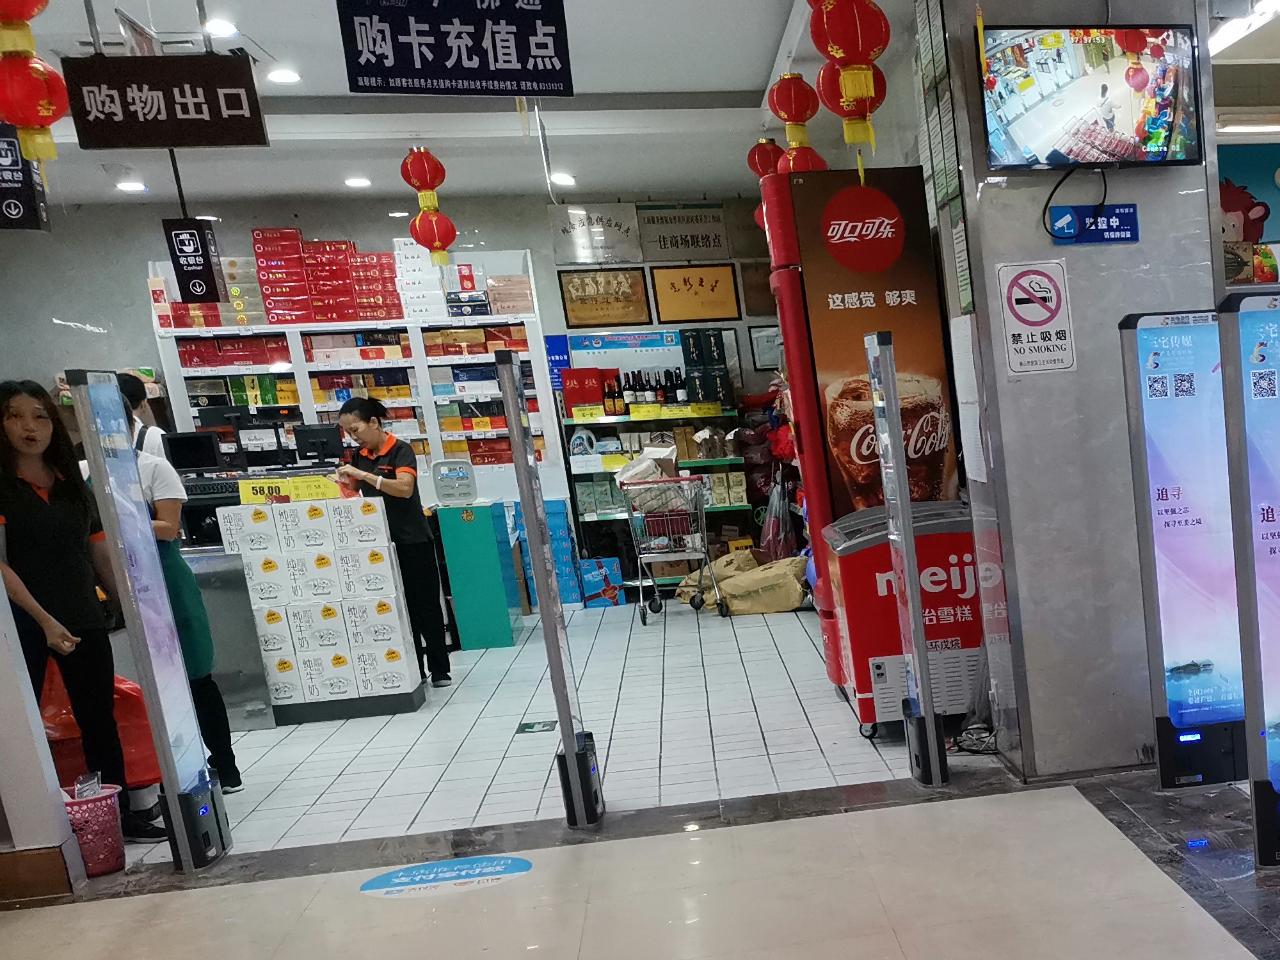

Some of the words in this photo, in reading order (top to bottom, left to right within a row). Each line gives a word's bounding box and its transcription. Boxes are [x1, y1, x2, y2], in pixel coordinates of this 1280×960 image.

[353, 15, 562, 70] 购卡充值点
[82, 85, 251, 123] 购物出口
[827, 216, 898, 243] 可口可乐
[179, 256, 204, 265] 收银台
[827, 292, 876, 310] 这感觉
[885, 289, 917, 307] 够爽
[1011, 329, 1067, 345] 禁止吸烟
[1013, 346, 1026, 356] NO
[1028, 343, 1067, 354] SMOKING
[1156, 486, 1183, 501] 追寻
